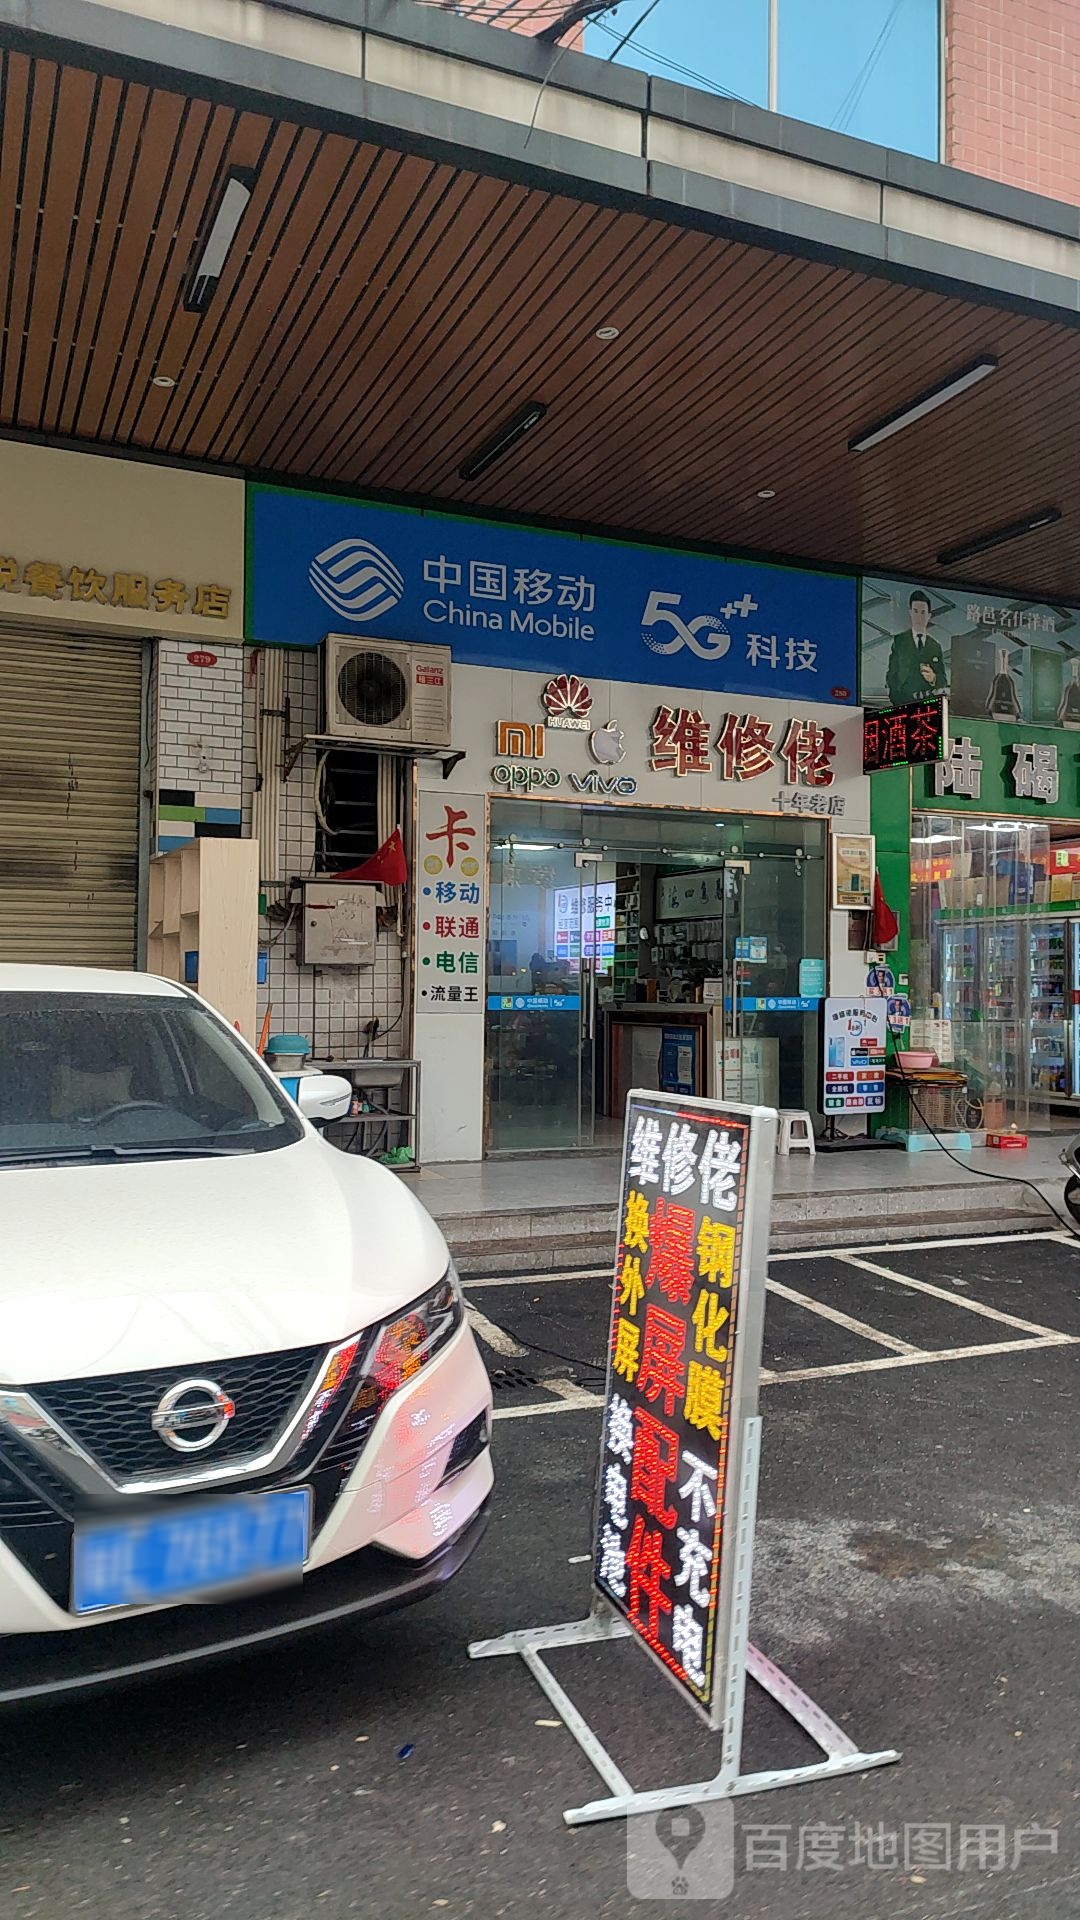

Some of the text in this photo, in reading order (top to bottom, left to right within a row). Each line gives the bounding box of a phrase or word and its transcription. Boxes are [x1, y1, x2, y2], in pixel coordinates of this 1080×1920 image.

[423, 554, 595, 612] 中国移动
[423, 599, 595, 642] China Mobile
[193, 654, 211, 664] 279
[746, 634, 818, 673] 科技
[416, 664, 444, 674] Galanz
[547, 716, 592, 731] HUAWEI
[650, 704, 837, 788] 维修佬
[771, 791, 846, 817] 十年老店
[425, 804, 477, 869] 卡
[435, 881, 480, 905] 移动
[434, 915, 480, 939] 联通
[436, 951, 480, 974] 电信
[430, 984, 479, 1002] 流量王
[628, 1115, 742, 1212] 维修佬
[683, 1215, 737, 1441] 钢化膜
